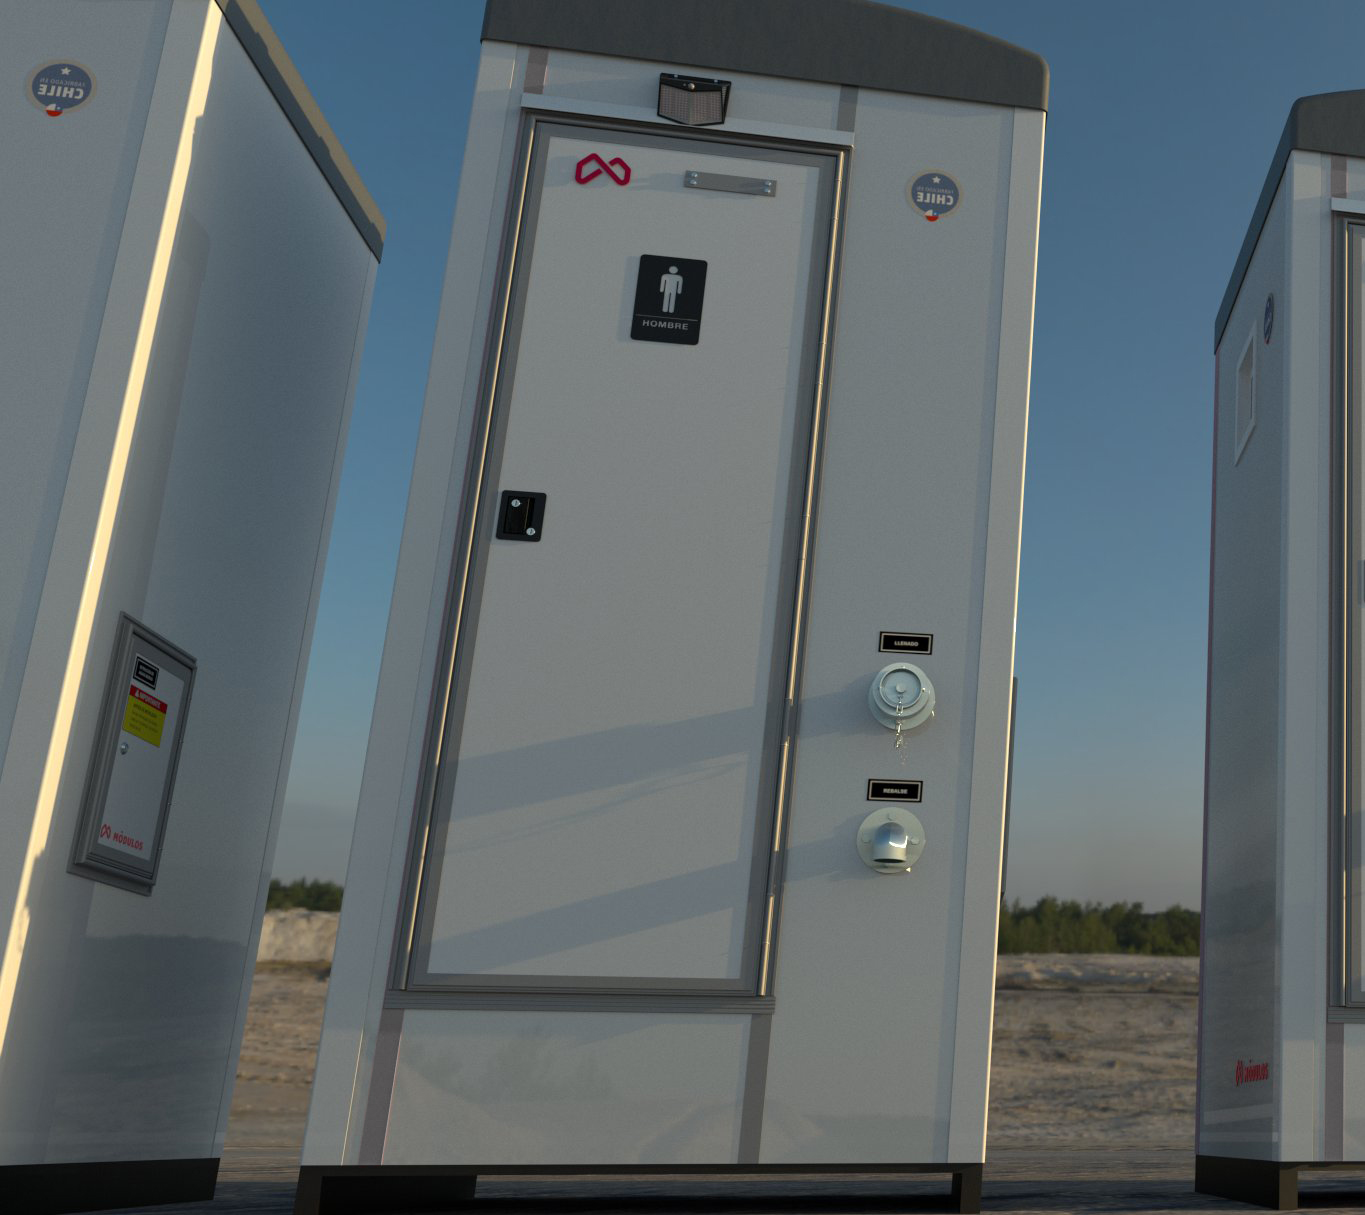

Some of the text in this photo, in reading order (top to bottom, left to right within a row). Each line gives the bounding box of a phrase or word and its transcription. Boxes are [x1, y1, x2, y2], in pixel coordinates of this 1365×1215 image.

[642, 319, 689, 331] HOMBRE
[893, 640, 920, 648] LLENADO
[882, 787, 909, 795] REBALSE
